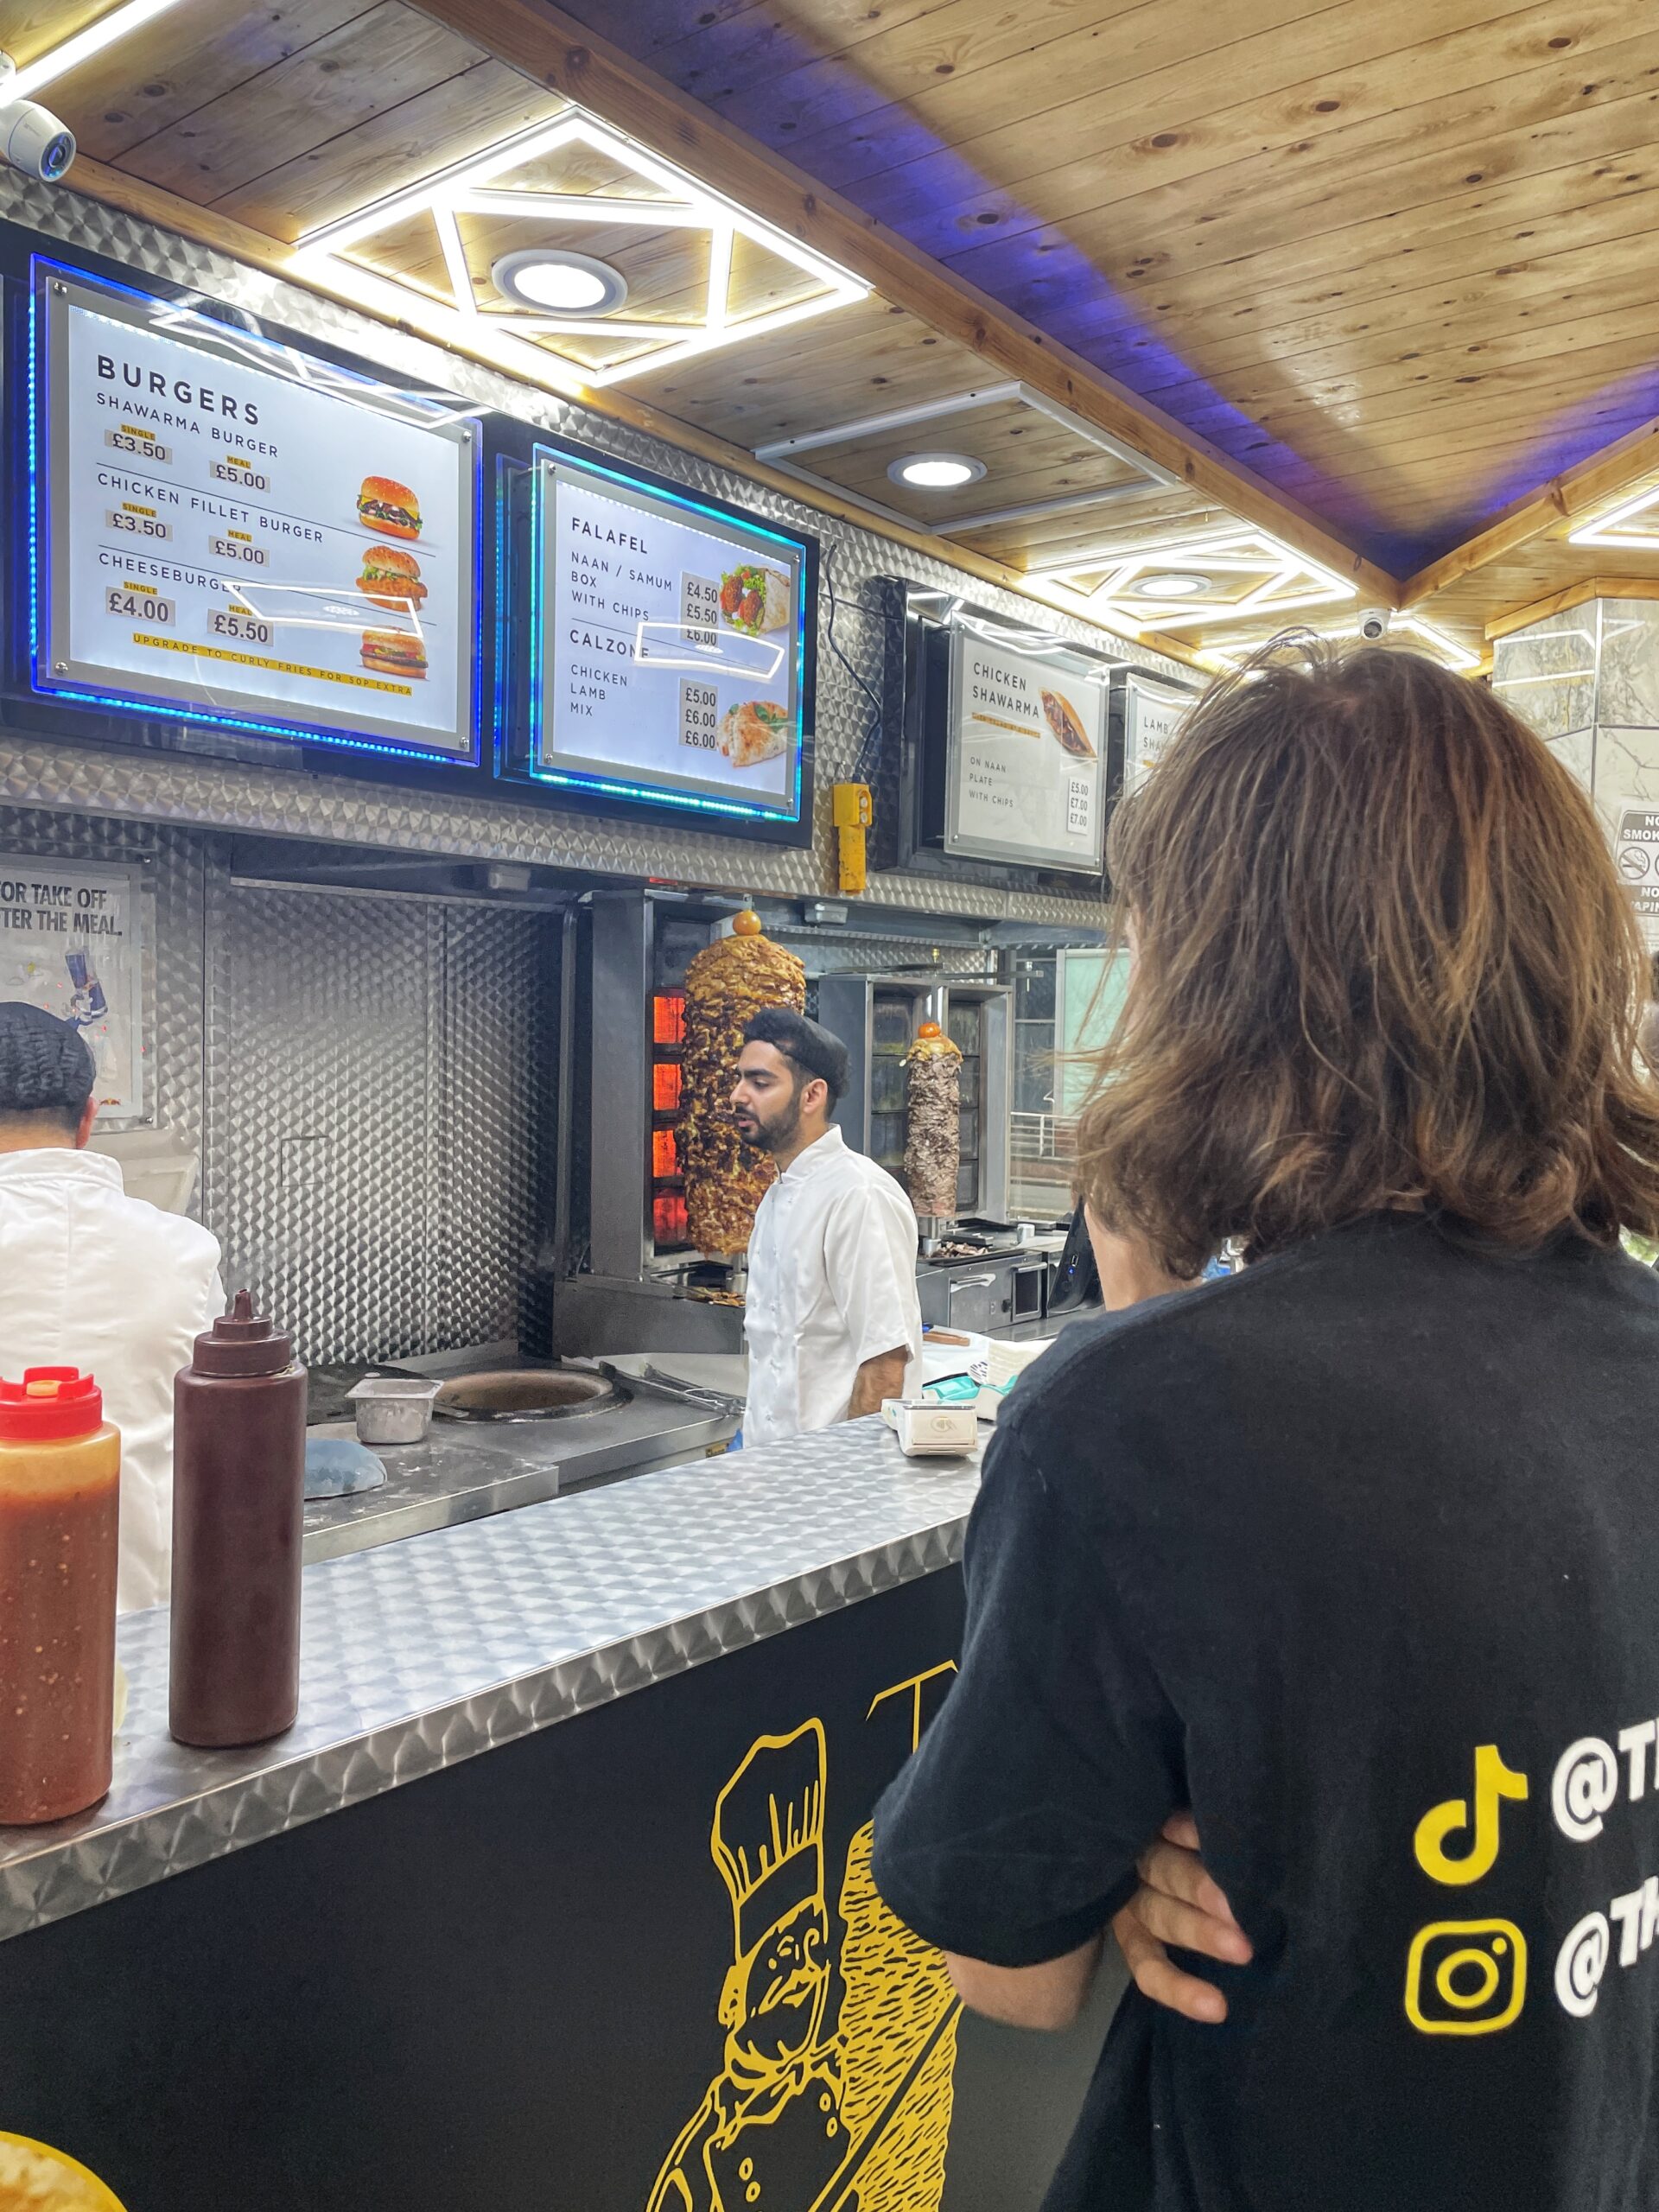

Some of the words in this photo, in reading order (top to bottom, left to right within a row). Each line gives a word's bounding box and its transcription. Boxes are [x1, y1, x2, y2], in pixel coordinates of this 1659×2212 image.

[98, 354, 258, 425] BURGERS
[97, 392, 200, 434] SHAWARMA
[212, 428, 277, 457] BURGER
[122, 424, 156, 441] SINGLE
[112, 433, 166, 461] £3.50
[227, 456, 251, 469] MEAL
[216, 465, 265, 490] £5.00
[98, 474, 179, 505] CHICKEN
[191, 498, 250, 523] FILLET
[260, 517, 322, 543] BURGER
[122, 503, 156, 518] SINGLE
[112, 513, 166, 538] £3.50
[572, 517, 647, 554] FALAFEL
[228, 530, 251, 543] MEAL
[215, 540, 264, 565] £5.00
[571, 551, 608, 572] NAAN
[629, 569, 672, 591] SAMUM
[571, 571, 597, 588] BOX
[124, 582, 157, 594] SINGLE
[687, 582, 717, 603] £4.50
[109, 592, 168, 622] £4.00
[571, 589, 605, 609] WITH
[613, 602, 649, 620] CHIPS
[687, 603, 717, 624] £5.50
[214, 614, 268, 643] £5.50
[133, 632, 198, 654] UPGRADE
[207, 649, 222, 658] TO
[232, 653, 270, 668] CURLY
[278, 663, 312, 676] FRIES
[320, 671, 341, 682] FOR
[377, 682, 412, 696] EXTRA
[571, 664, 627, 686] CHICKEN
[974, 662, 1027, 691] CHICKEN
[570, 683, 606, 700] LAMB
[685, 688, 716, 707] £5.00
[973, 685, 1039, 719] SHAWARMA
[570, 702, 593, 716] MIX
[685, 709, 715, 728] £6.00
[1144, 715, 1169, 734] LAMB
[685, 730, 715, 749] £6.00
[970, 756, 981, 766] ON
[985, 760, 1006, 772] NAAN
[969, 772, 993, 786] PLATE
[1071, 781, 1089, 796] £5.00
[969, 789, 988, 802] WITH
[992, 795, 1014, 808] CHIPS
[1071, 798, 1087, 810] £7.00
[1071, 812, 1087, 827] £7.00
[0, 880, 27, 903] OR
[31, 884, 72, 906] TAKE
[77, 887, 107, 910] OFF
[1641, 887, 1659, 898] NO
[0, 907, 32, 930] TER
[36, 910, 67, 932] THE
[73, 912, 123, 936] MEAL.
